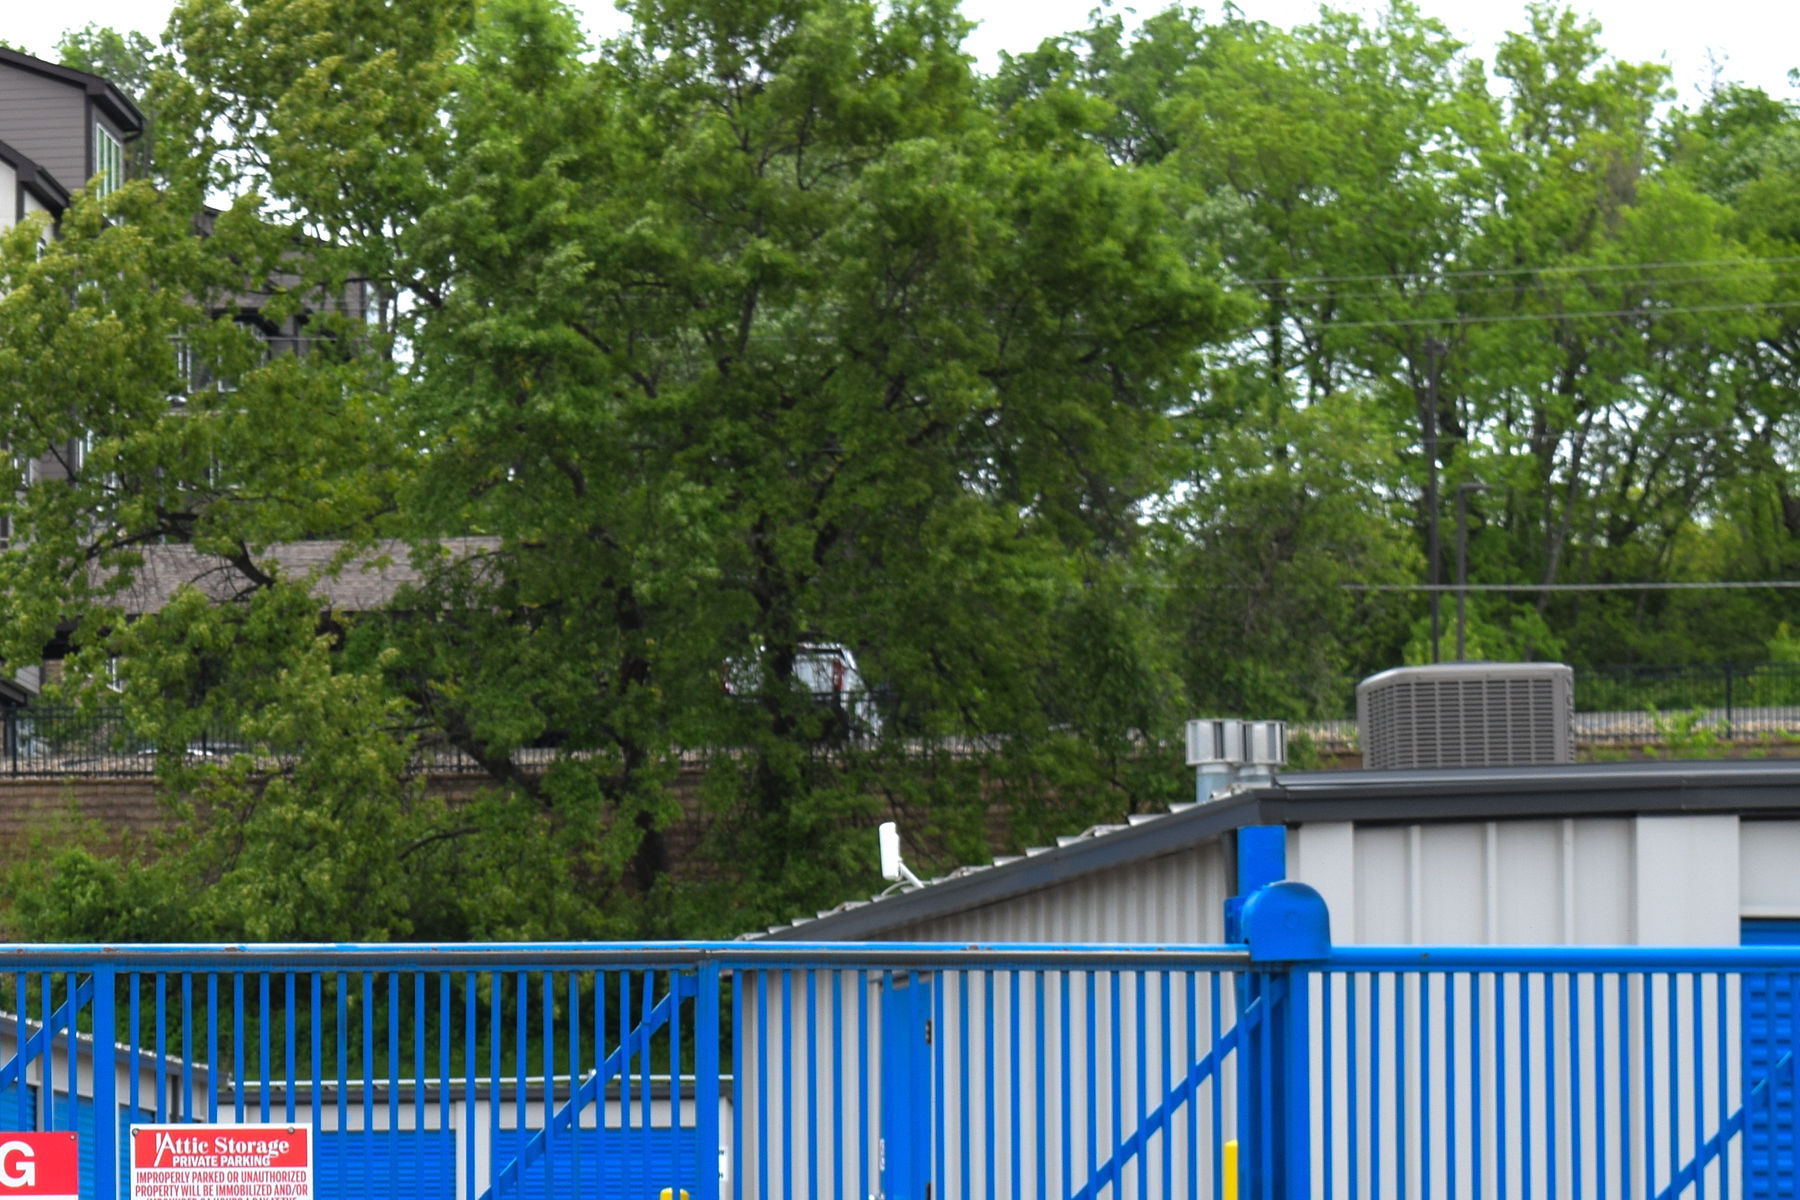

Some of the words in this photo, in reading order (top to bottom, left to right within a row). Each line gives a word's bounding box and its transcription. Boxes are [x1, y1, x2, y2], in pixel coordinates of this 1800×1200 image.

[214, 1137, 289, 1158] Storage
[173, 1155, 217, 1166] PRIVATE
[220, 1155, 271, 1166] PARKING
[137, 1171, 190, 1184] IMPROPERLY
[191, 1171, 225, 1183] PARKED
[227, 1171, 239, 1182] OR
[241, 1171, 307, 1182] UNAUTHORIZED
[135, 1185, 179, 1197] PROPERTY
[181, 1185, 200, 1196] WILL
[203, 1185, 214, 1196] BE
[215, 1184, 271, 1196] IMMOBILIZED
[274, 1184, 308, 1196] AND/OR
